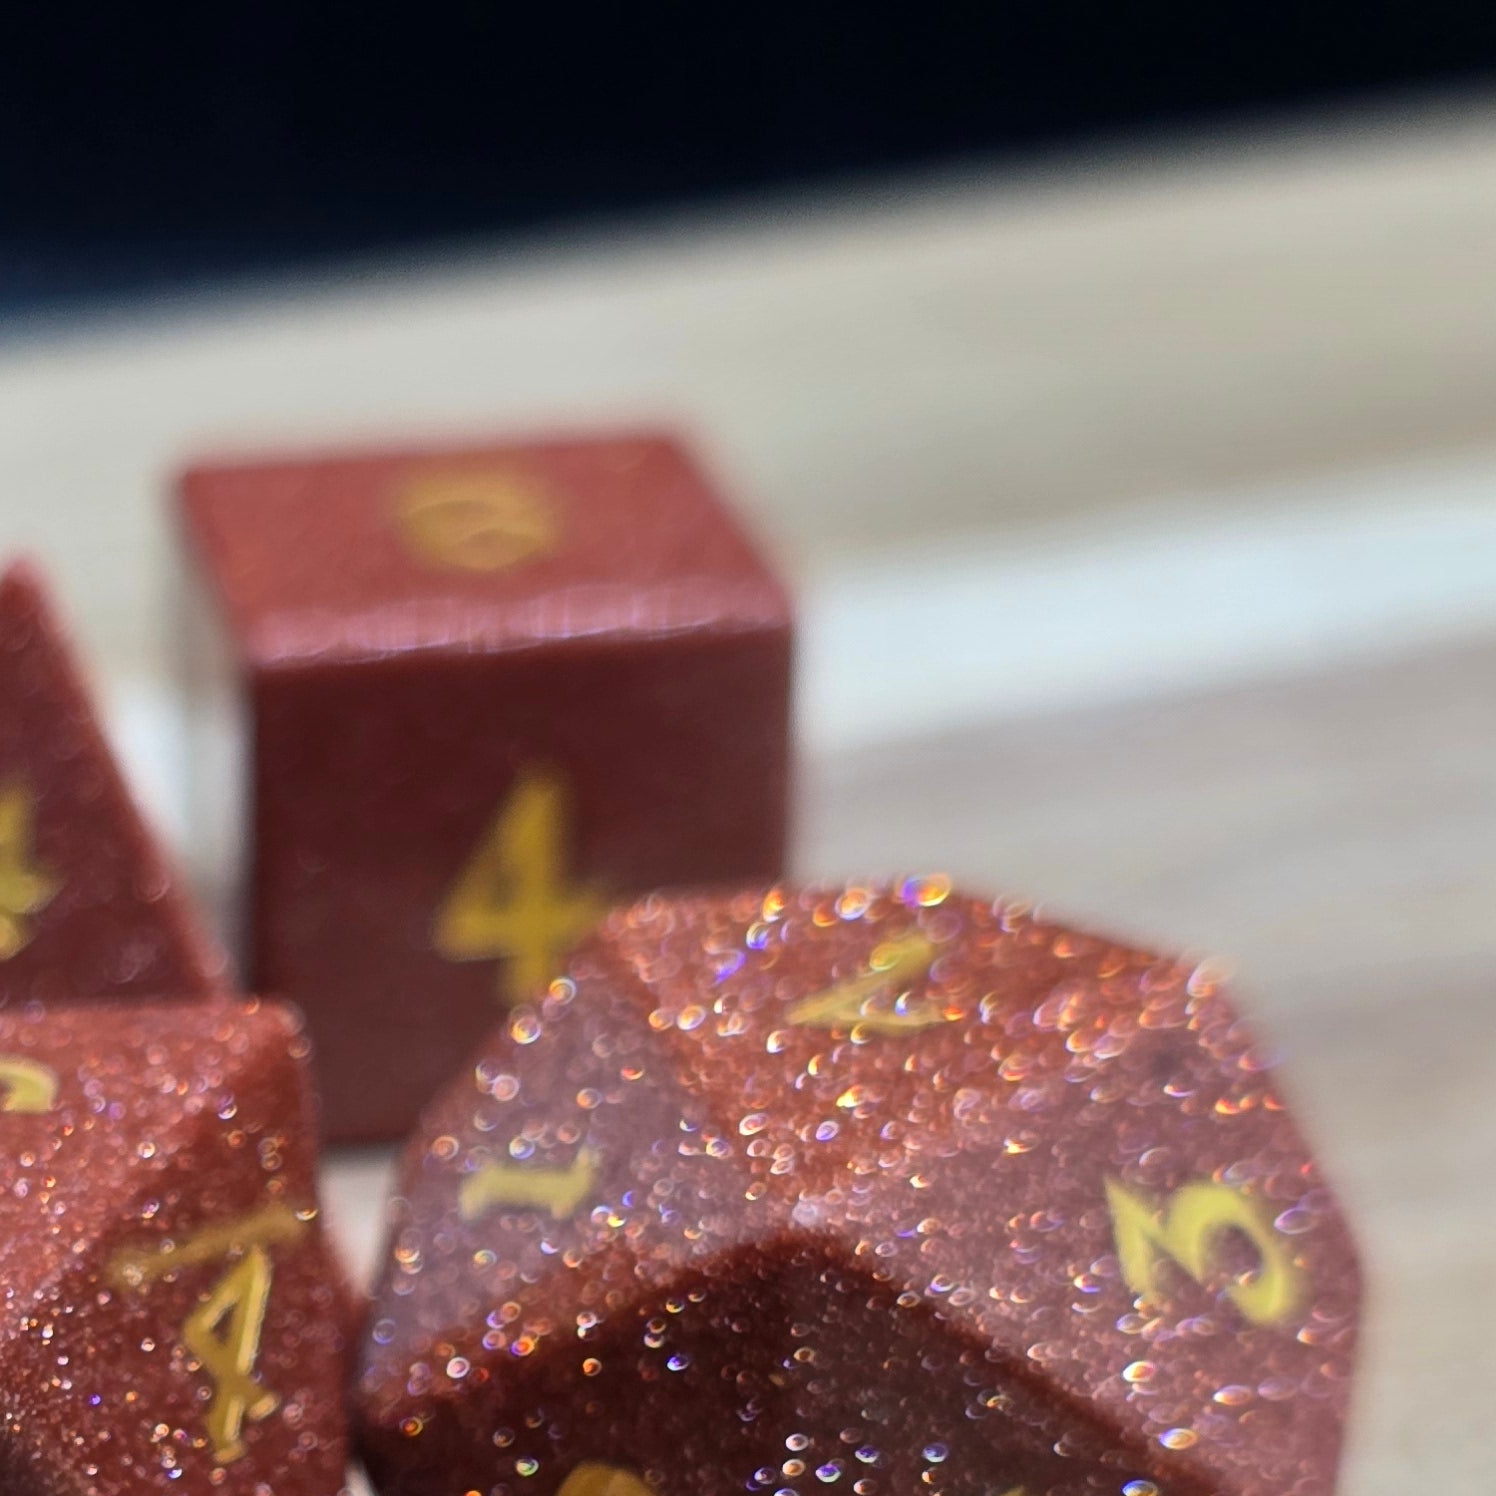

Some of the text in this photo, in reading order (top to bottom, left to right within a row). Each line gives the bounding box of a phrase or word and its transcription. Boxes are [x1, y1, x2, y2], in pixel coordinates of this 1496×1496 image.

[439, 765, 609, 1005] 4
[456, 1148, 601, 1222] 1
[1104, 1172, 1296, 1326] 3
